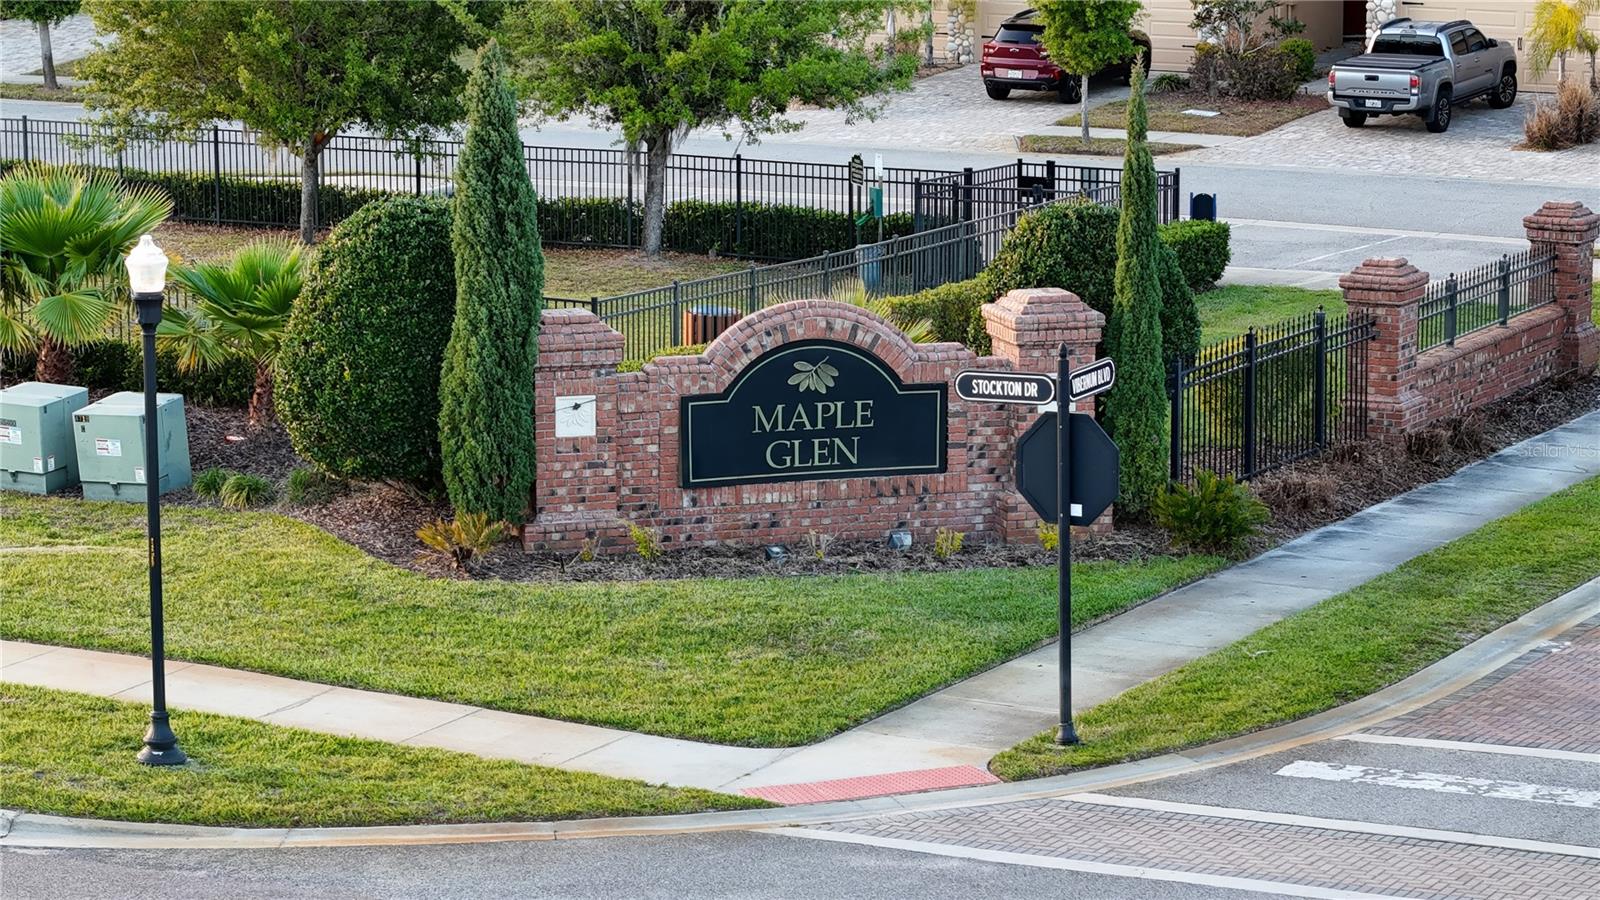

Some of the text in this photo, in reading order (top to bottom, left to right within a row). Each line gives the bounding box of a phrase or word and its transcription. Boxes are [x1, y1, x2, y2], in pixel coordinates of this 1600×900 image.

[971, 379, 1038, 397] STOCKTON DR
[1098, 366, 1111, 385] BLVD
[752, 401, 874, 432] MAPLE
[766, 437, 860, 468] GLEN
